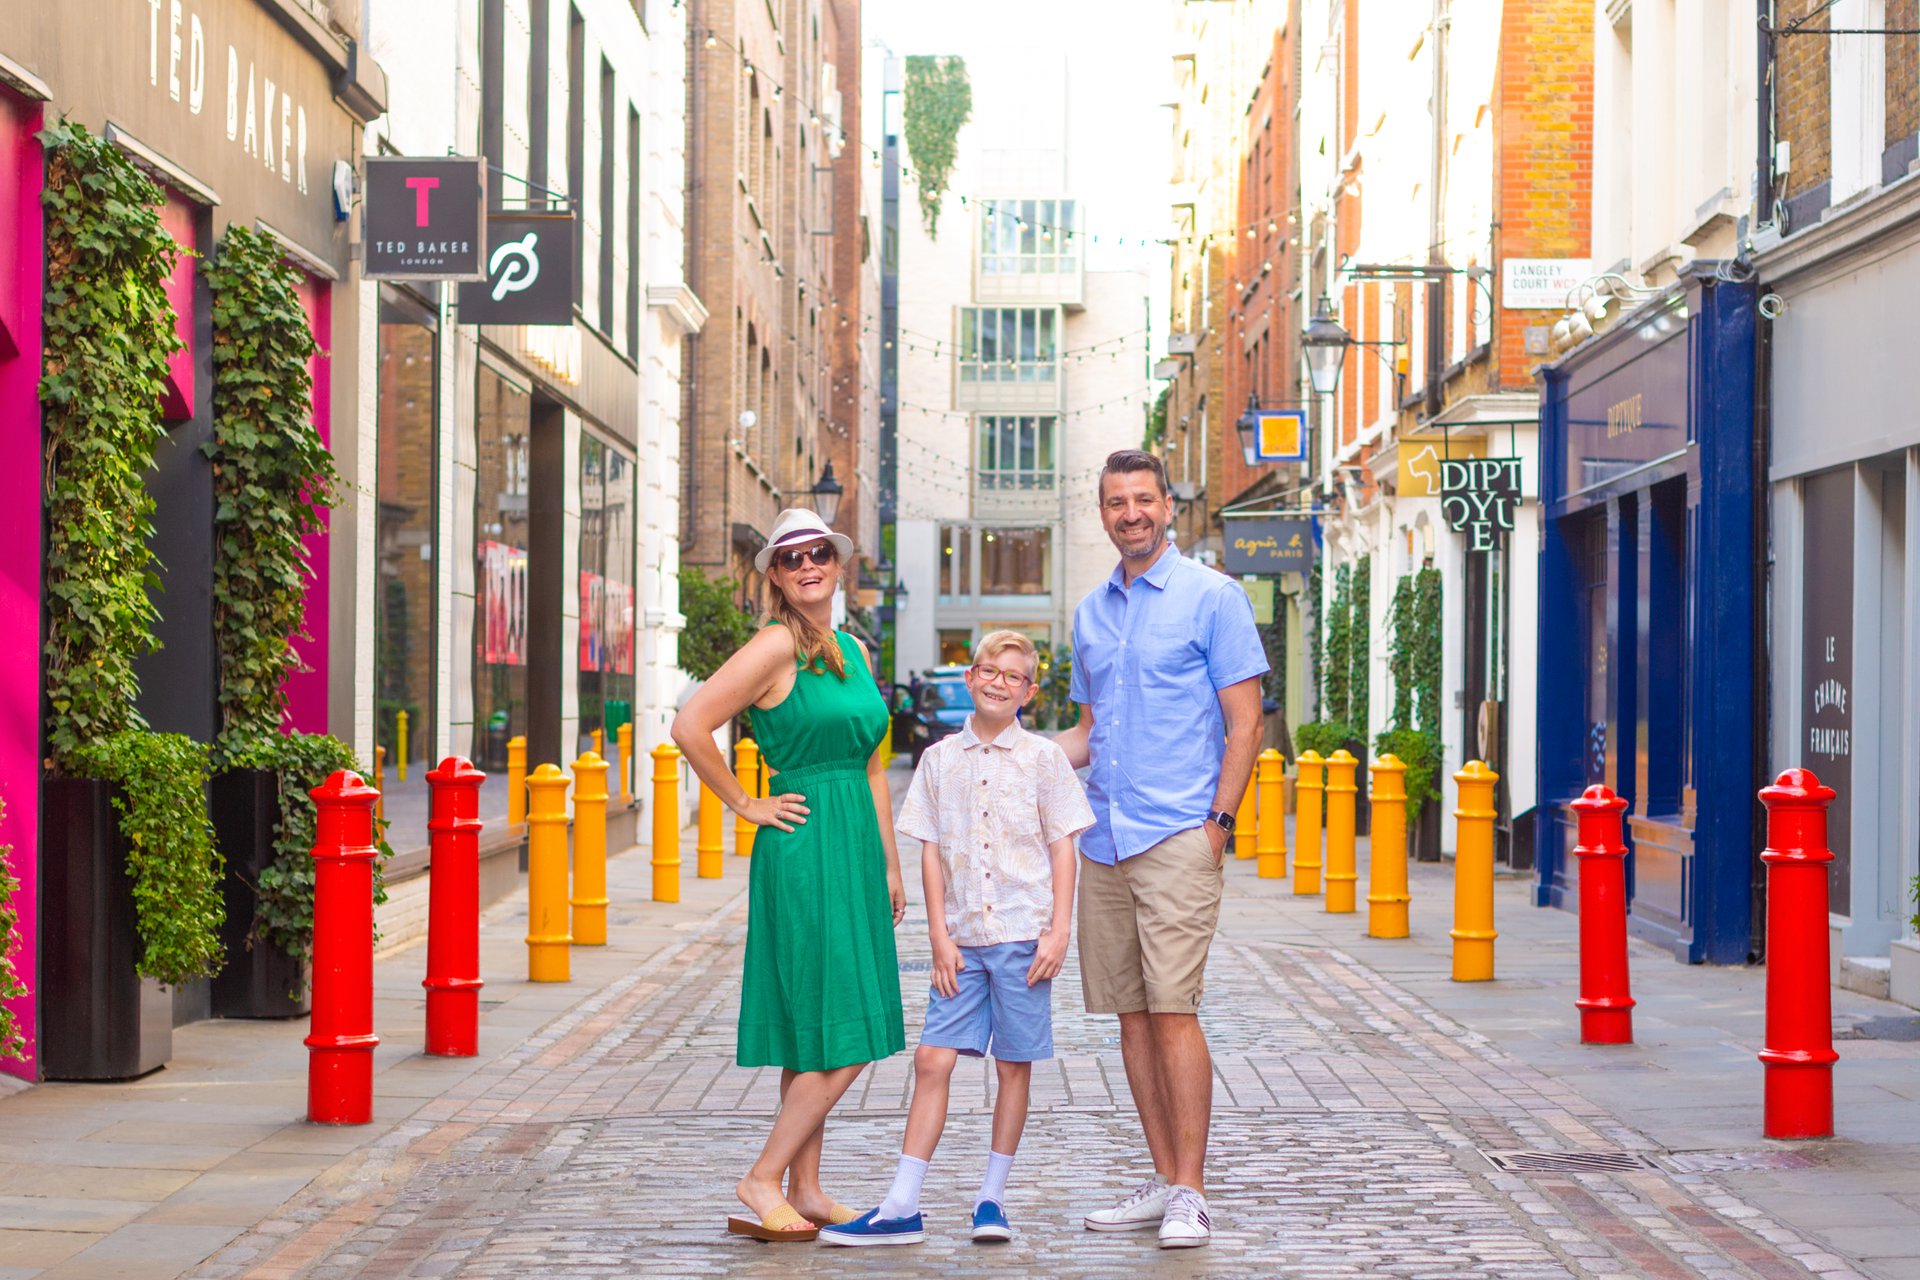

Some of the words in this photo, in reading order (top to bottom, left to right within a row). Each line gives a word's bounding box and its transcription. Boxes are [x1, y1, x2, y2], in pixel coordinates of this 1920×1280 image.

[148, 0, 205, 115] TED
[226, 44, 308, 196] BAKER
[406, 177, 440, 227] T
[376, 241, 406, 254] TED
[417, 241, 469, 254] BAKER
[400, 258, 444, 266] LONDON
[1513, 265, 1562, 276] LANGLEY
[1513, 278, 1548, 289] COURT
[1270, 550, 1303, 558] PARIS
[1826, 636, 1835, 662] LE
[1814, 679, 1847, 714] CHARME
[1810, 727, 1849, 761] FRANÇAIS
